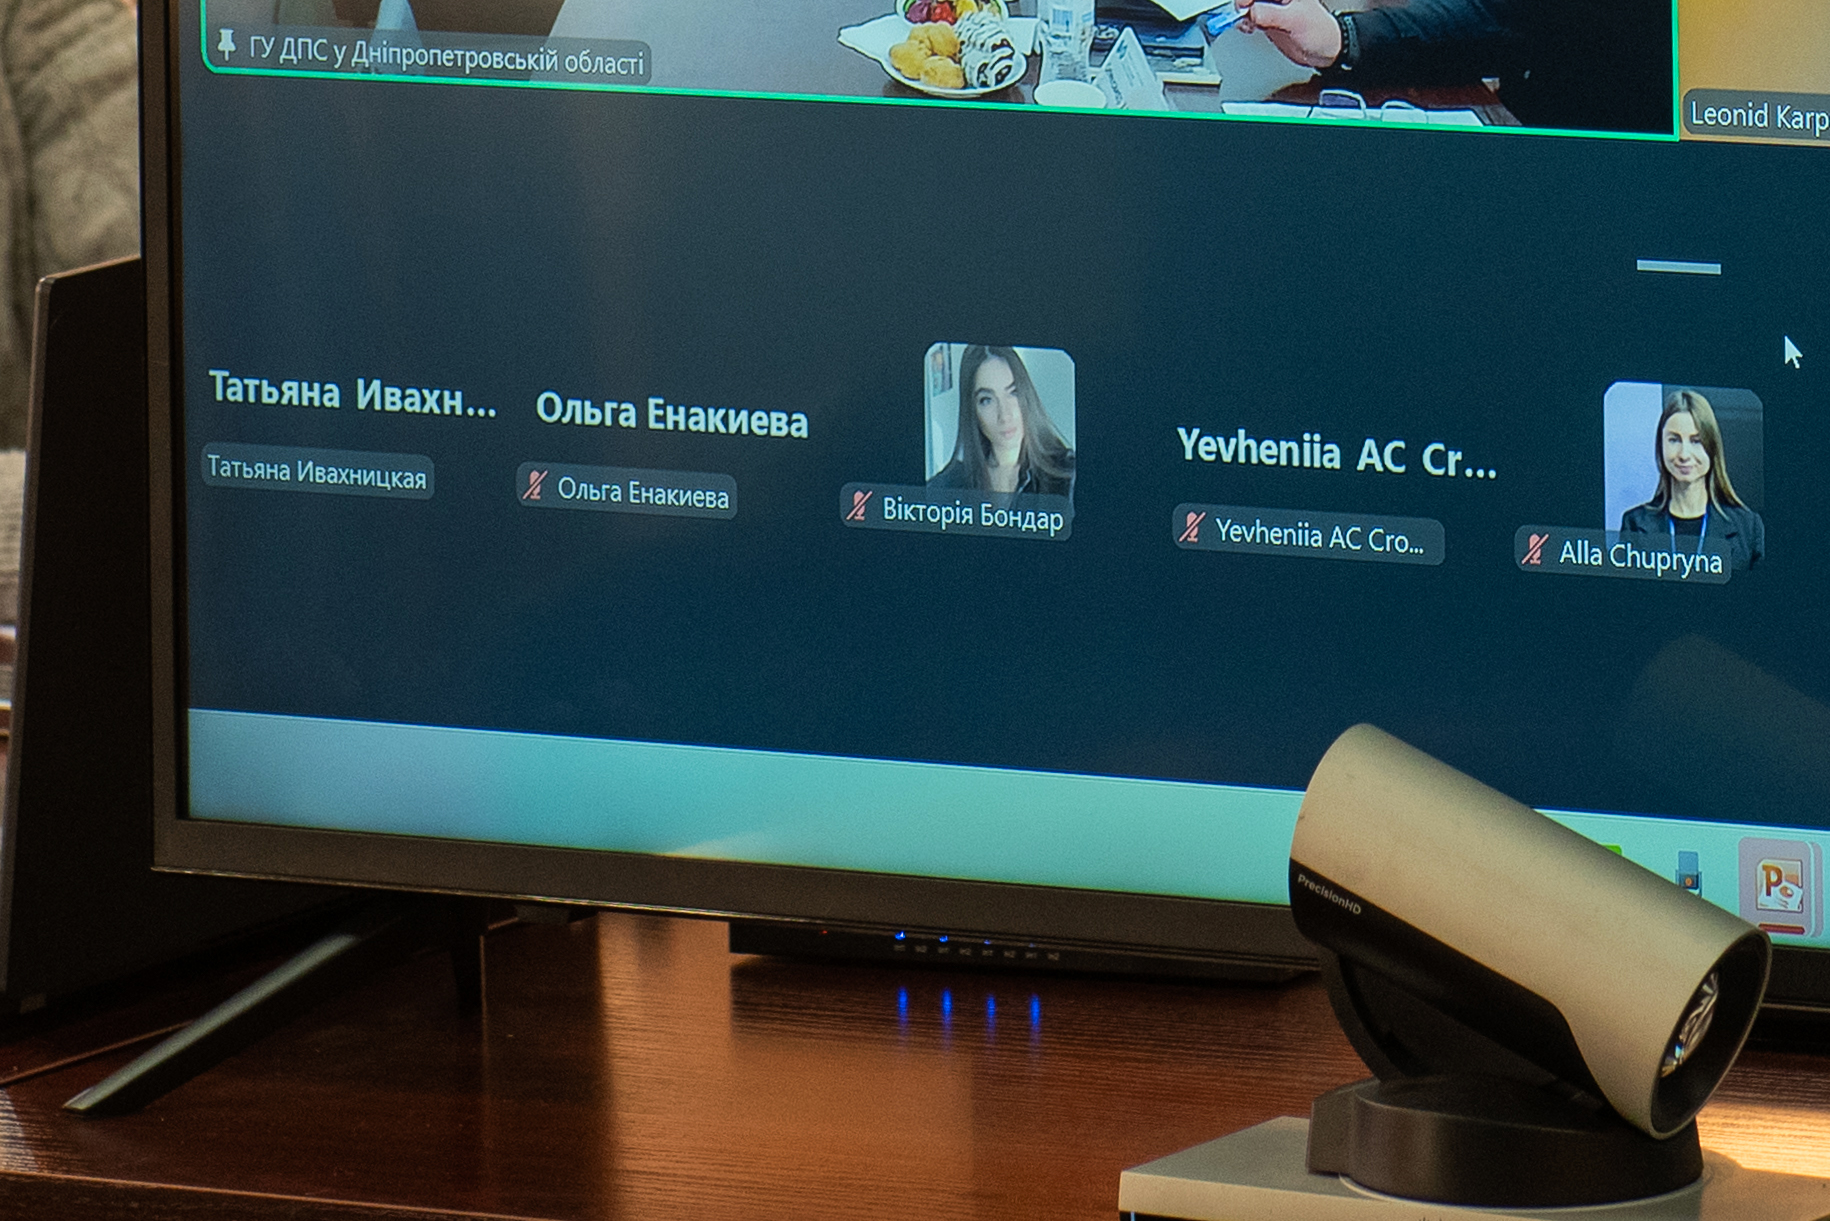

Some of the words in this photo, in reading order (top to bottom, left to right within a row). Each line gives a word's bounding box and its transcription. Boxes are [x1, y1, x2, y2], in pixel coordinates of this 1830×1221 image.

[251, 36, 274, 58] ГУ
[280, 37, 327, 64] ДПС
[334, 45, 346, 68] у
[352, 41, 557, 74] Дніпропетровській
[565, 50, 643, 74] області
[1693, 102, 1768, 127] Leonid
[209, 370, 339, 407] Татьяна
[357, 379, 495, 417] Ивахн...
[537, 392, 636, 427] Ольга
[648, 398, 808, 438] Енакиева
[1177, 428, 1340, 469] Yevheniia
[1357, 439, 1405, 473] AC
[207, 454, 290, 480] Татьяна
[298, 461, 426, 490] Ивахницкая
[558, 477, 621, 502] Ольга
[630, 481, 729, 509] Енакиева
[884, 496, 973, 528] Вікторія
[982, 504, 1063, 537] Бондар
[1216, 518, 1322, 547] Yevheniia
[1329, 526, 1361, 550] AC
[1560, 540, 1602, 565] Alla
[1610, 543, 1722, 578] Chupryna
[1297, 873, 1362, 915] PrecisionHD
